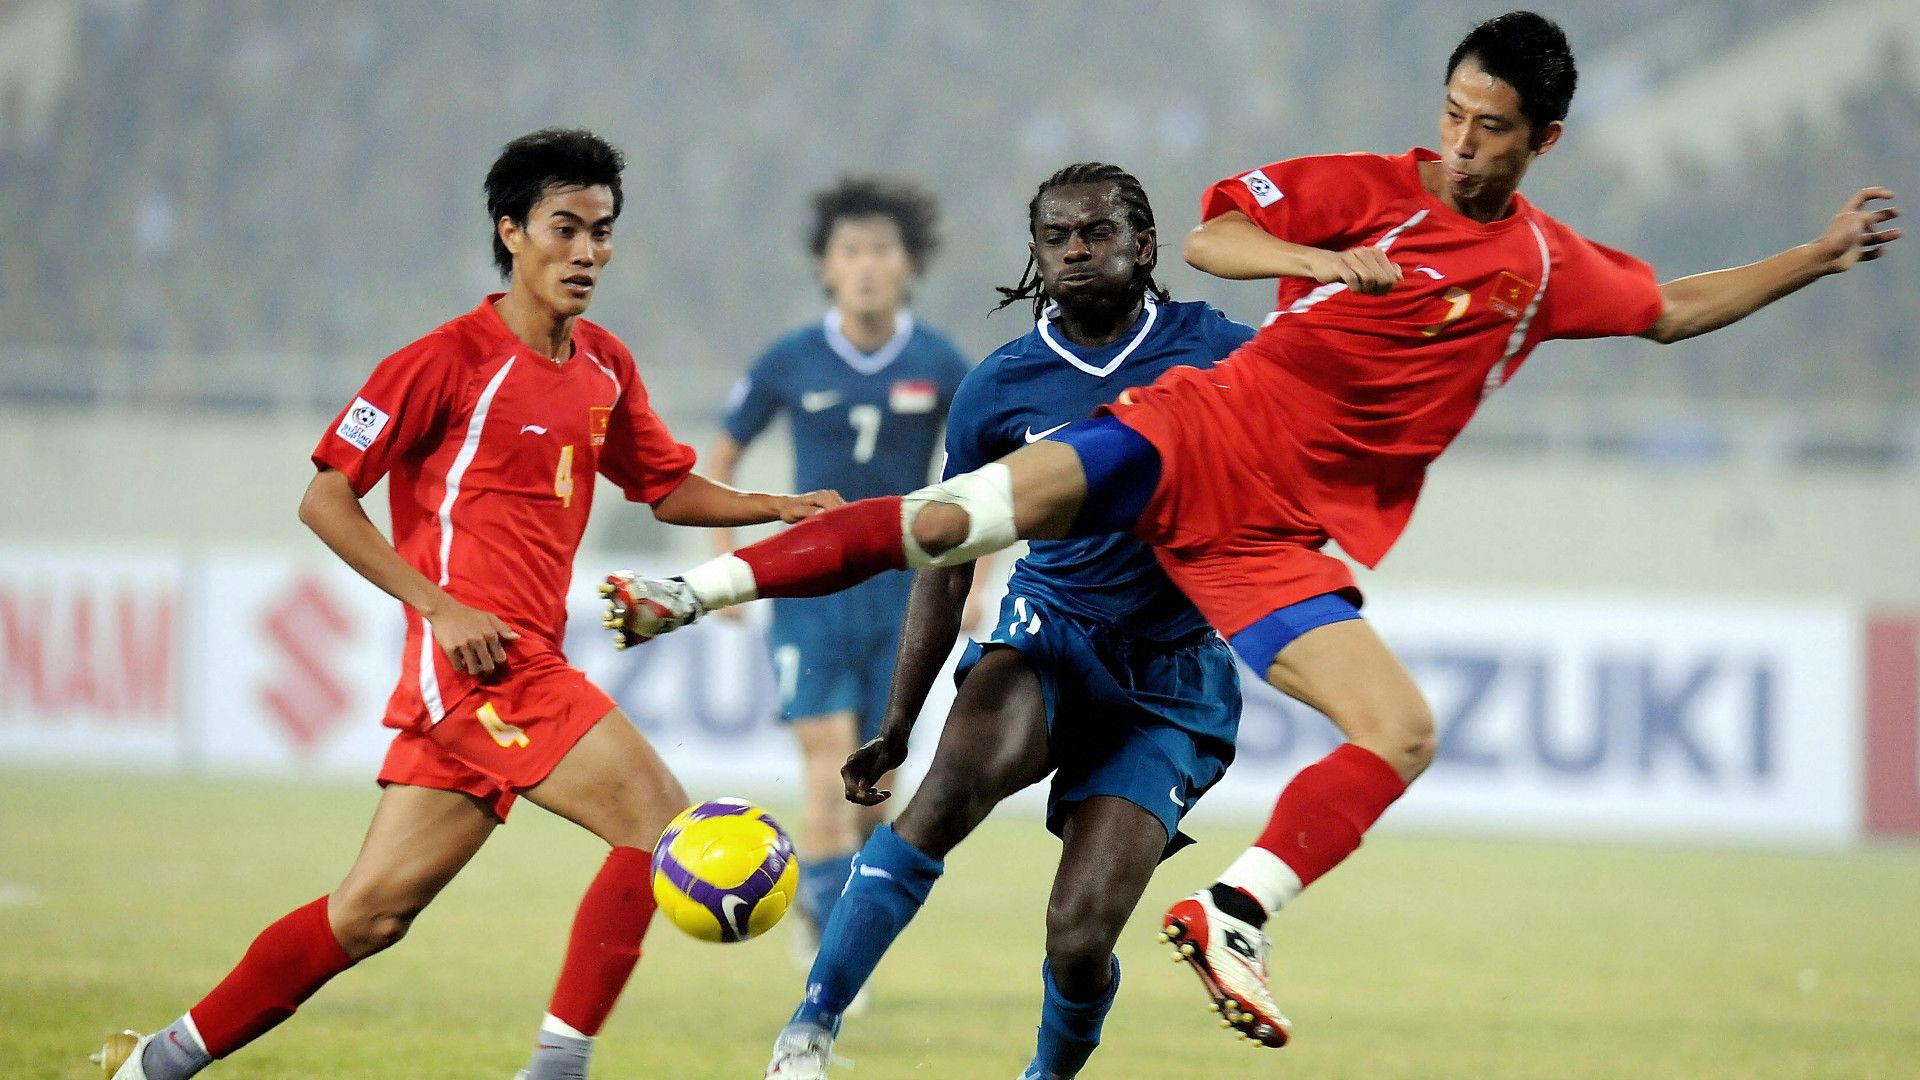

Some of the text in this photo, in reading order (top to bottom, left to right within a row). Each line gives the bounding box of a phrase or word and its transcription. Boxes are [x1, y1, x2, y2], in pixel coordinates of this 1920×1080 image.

[1421, 286, 1471, 334] 7
[848, 404, 882, 464] 7
[555, 445, 573, 508] 4
[476, 702, 530, 748] 4
[1238, 650, 1777, 778] SZUKI
